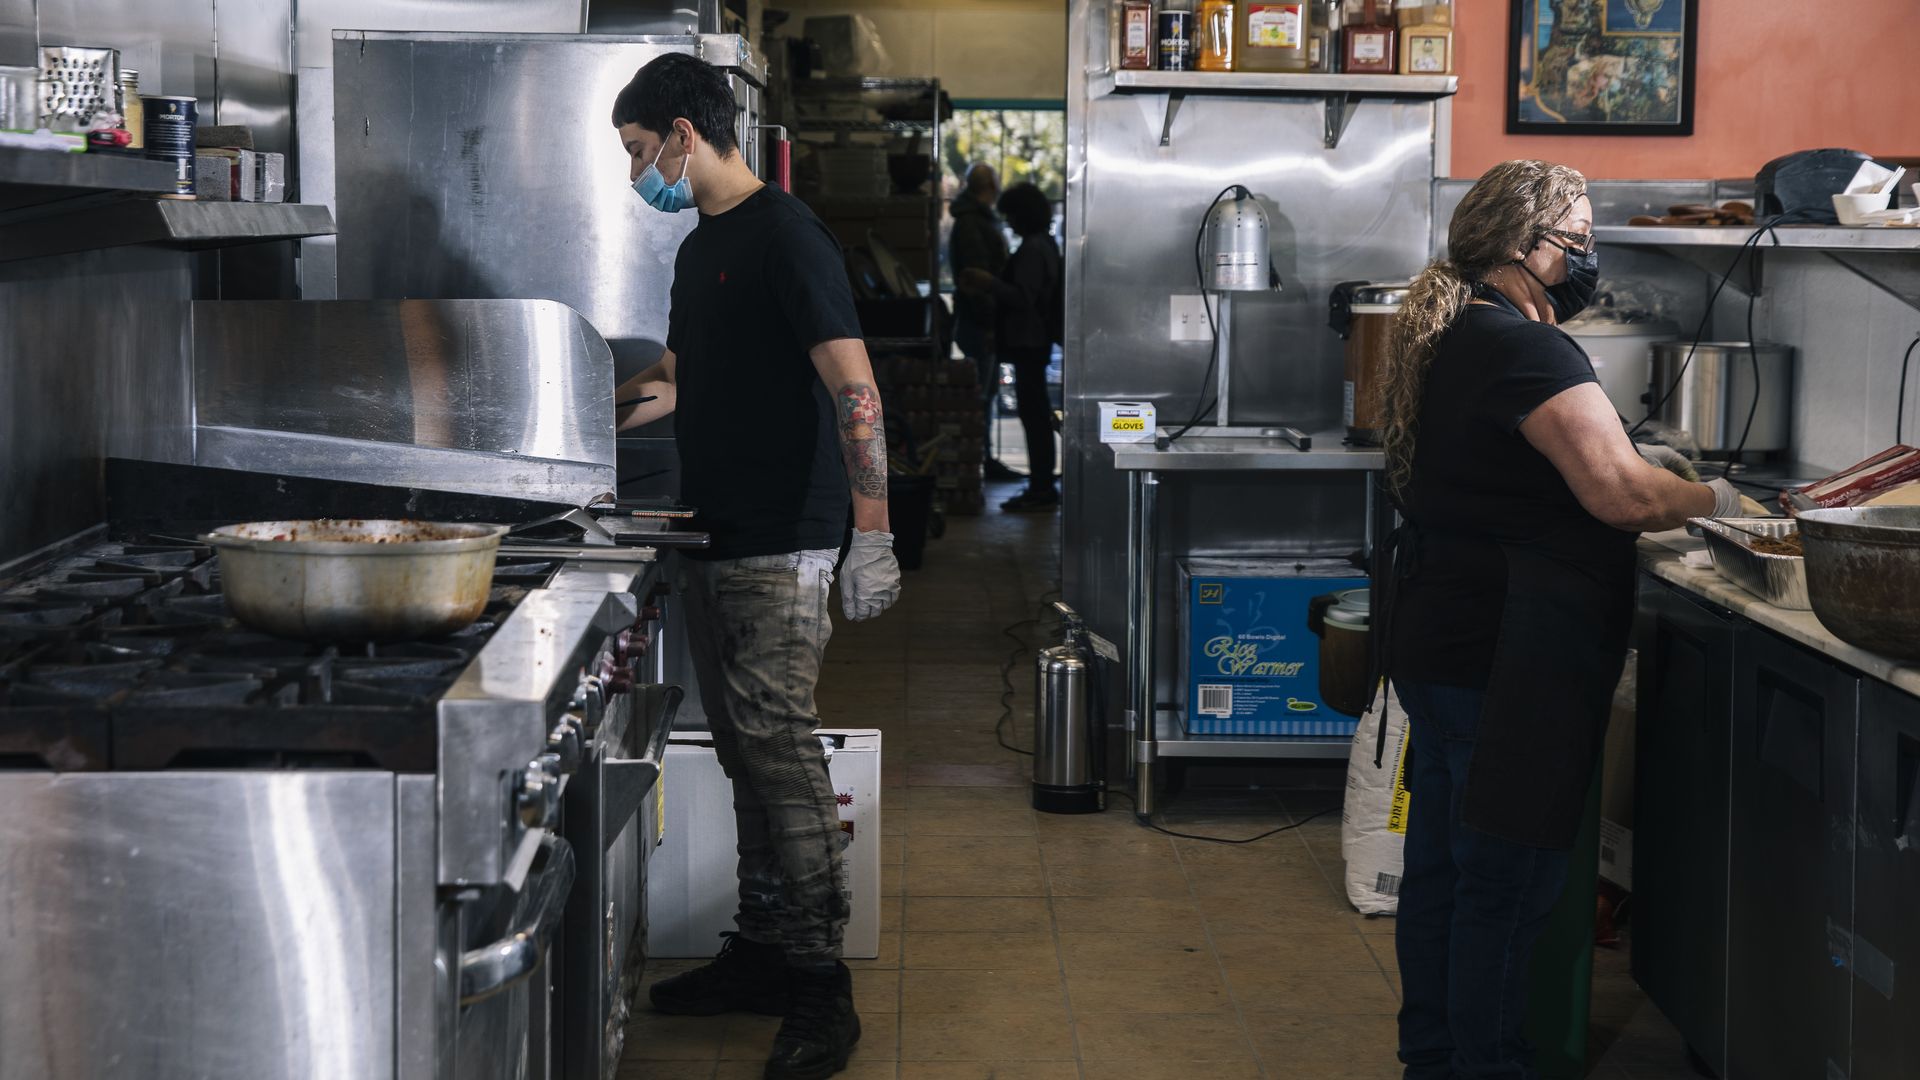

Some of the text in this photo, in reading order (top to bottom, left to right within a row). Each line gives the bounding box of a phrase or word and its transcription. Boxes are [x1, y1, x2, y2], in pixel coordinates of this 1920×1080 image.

[1160, 38, 1190, 46] MORTON
[1113, 422, 1144, 430] GLOVES
[1203, 636, 1258, 658] Rice
[1217, 655, 1304, 676] Warmer
[1390, 804, 1402, 830] RICE
